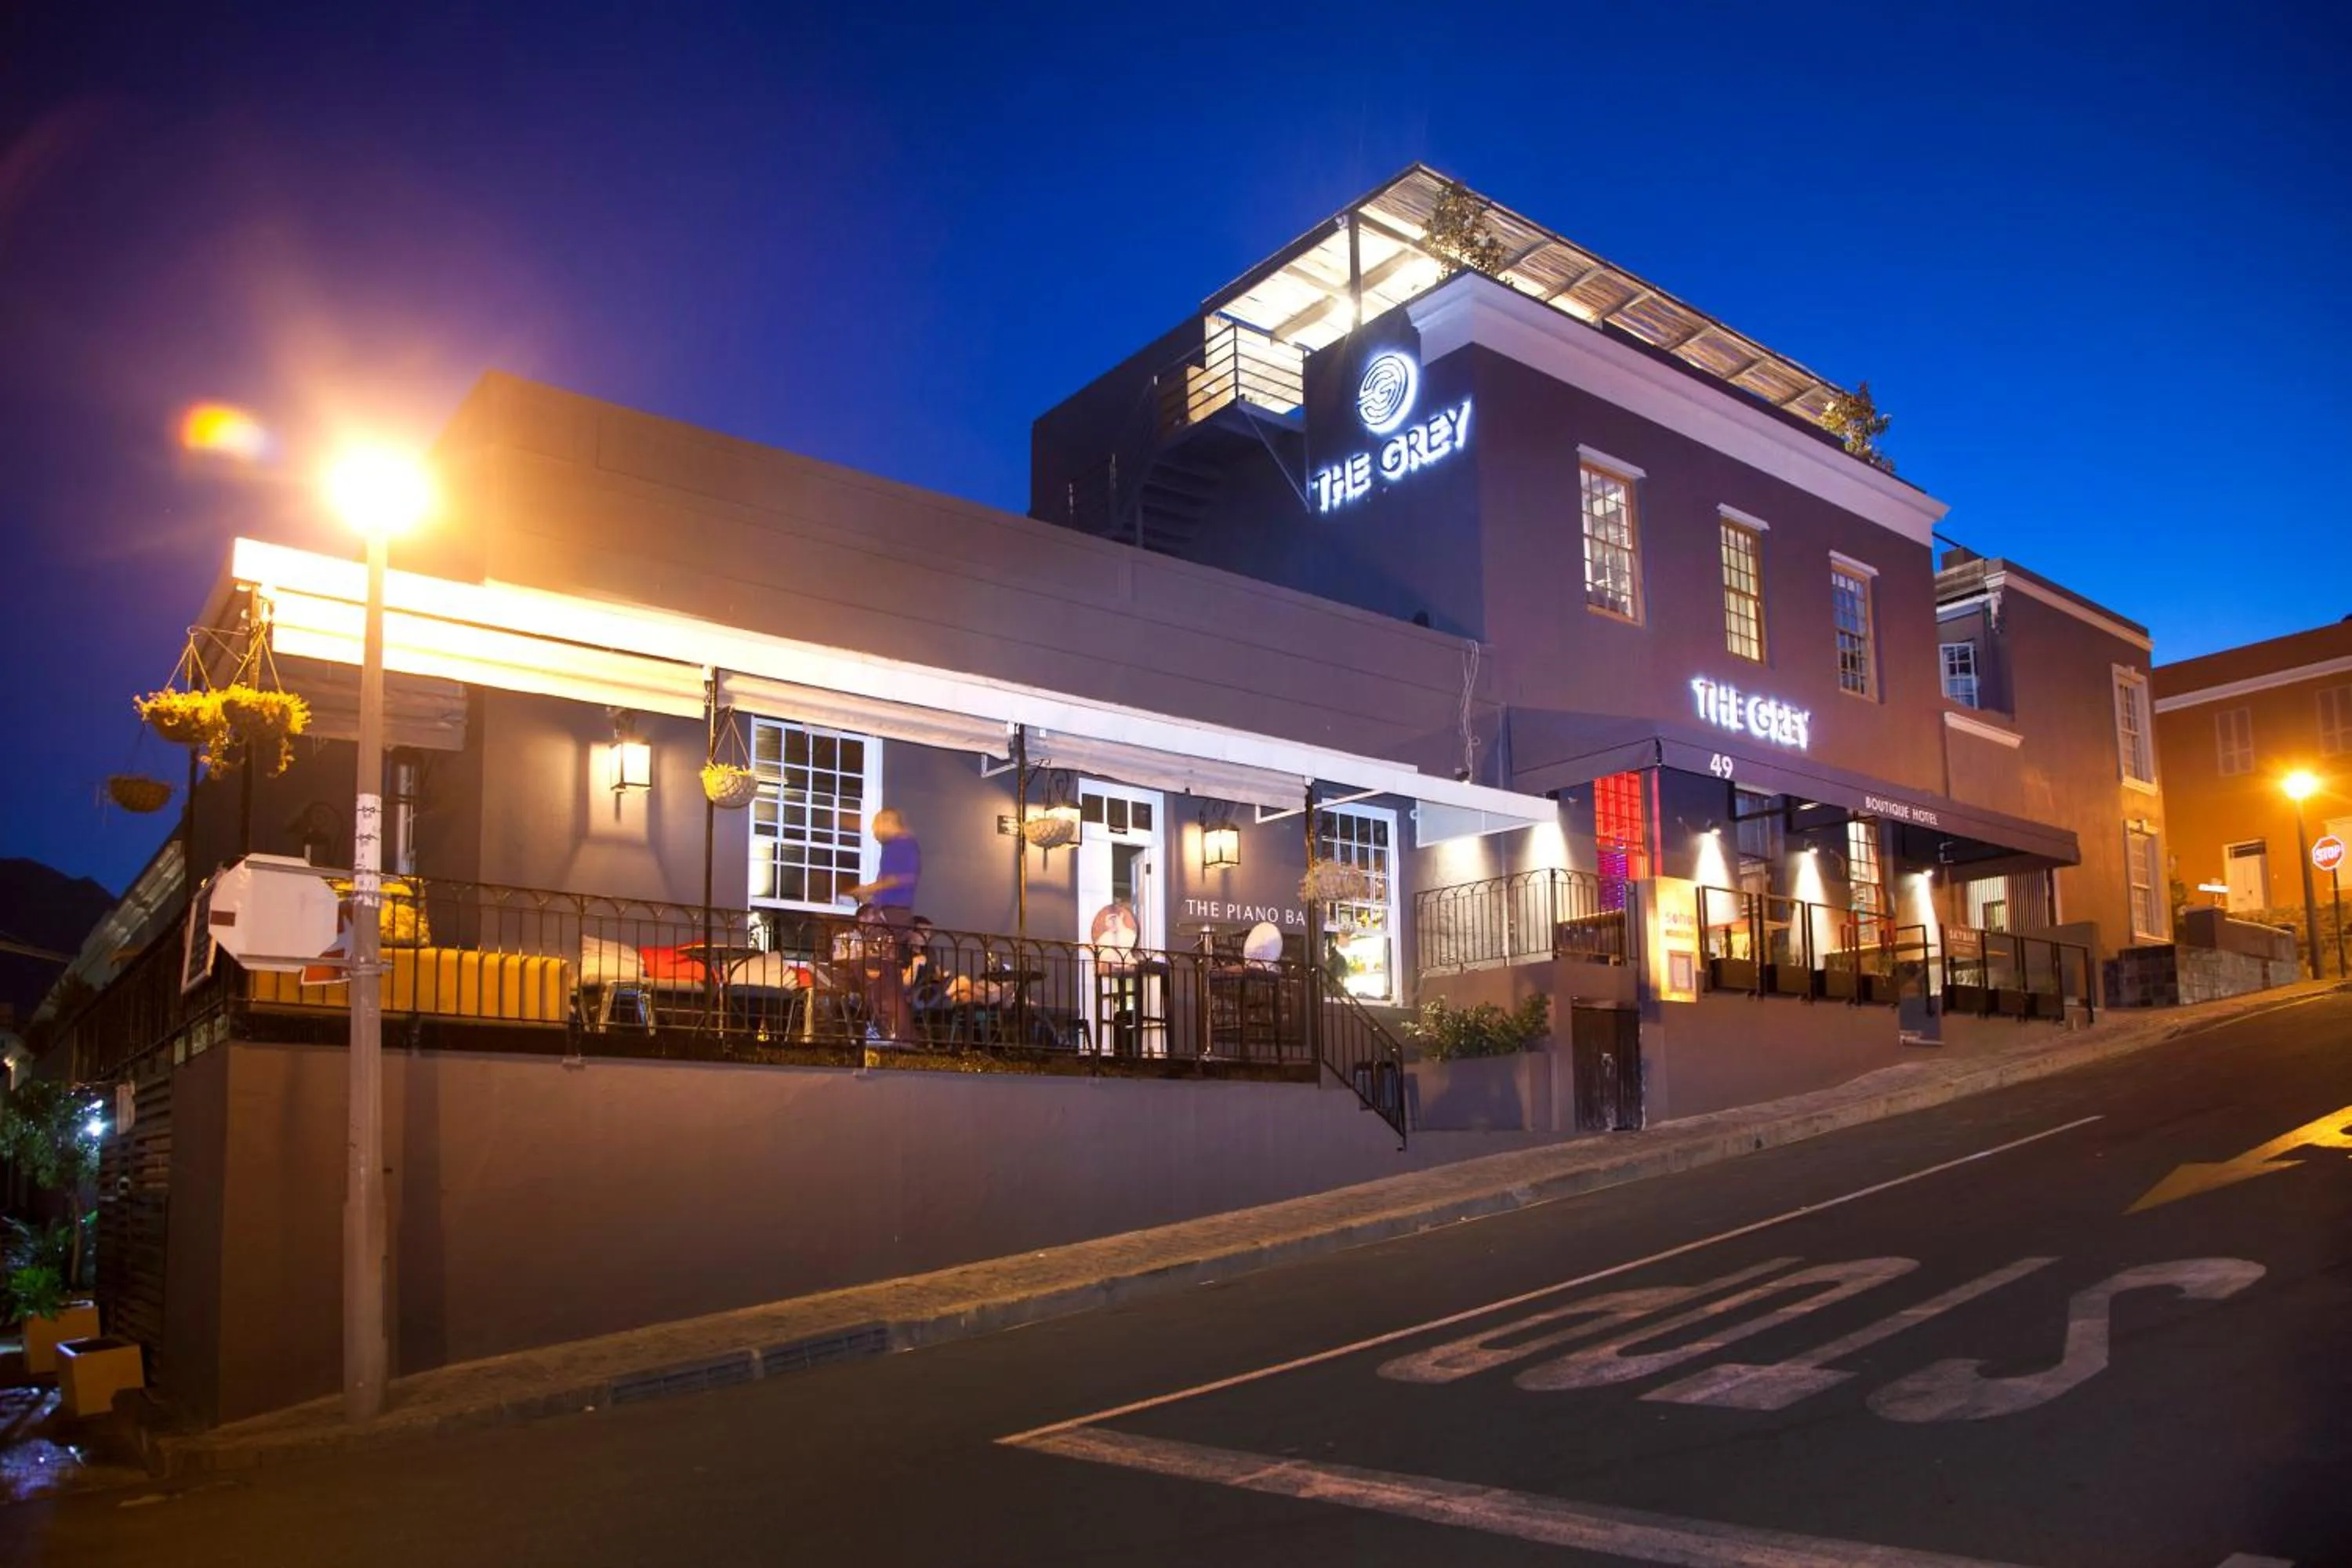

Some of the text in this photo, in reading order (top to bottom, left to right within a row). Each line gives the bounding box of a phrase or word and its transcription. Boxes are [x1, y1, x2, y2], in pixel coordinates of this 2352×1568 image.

[1312, 399, 1472, 513] THE GREY
[1691, 677, 1811, 750] THE GREY
[1710, 753, 1733, 779] 49
[1865, 796, 1939, 826] BOUTIQUE HOTEL
[2314, 844, 2341, 862] STOP
[1185, 899, 1305, 927] THE PIANO BA
[1376, 1256, 2267, 1423] STOP
